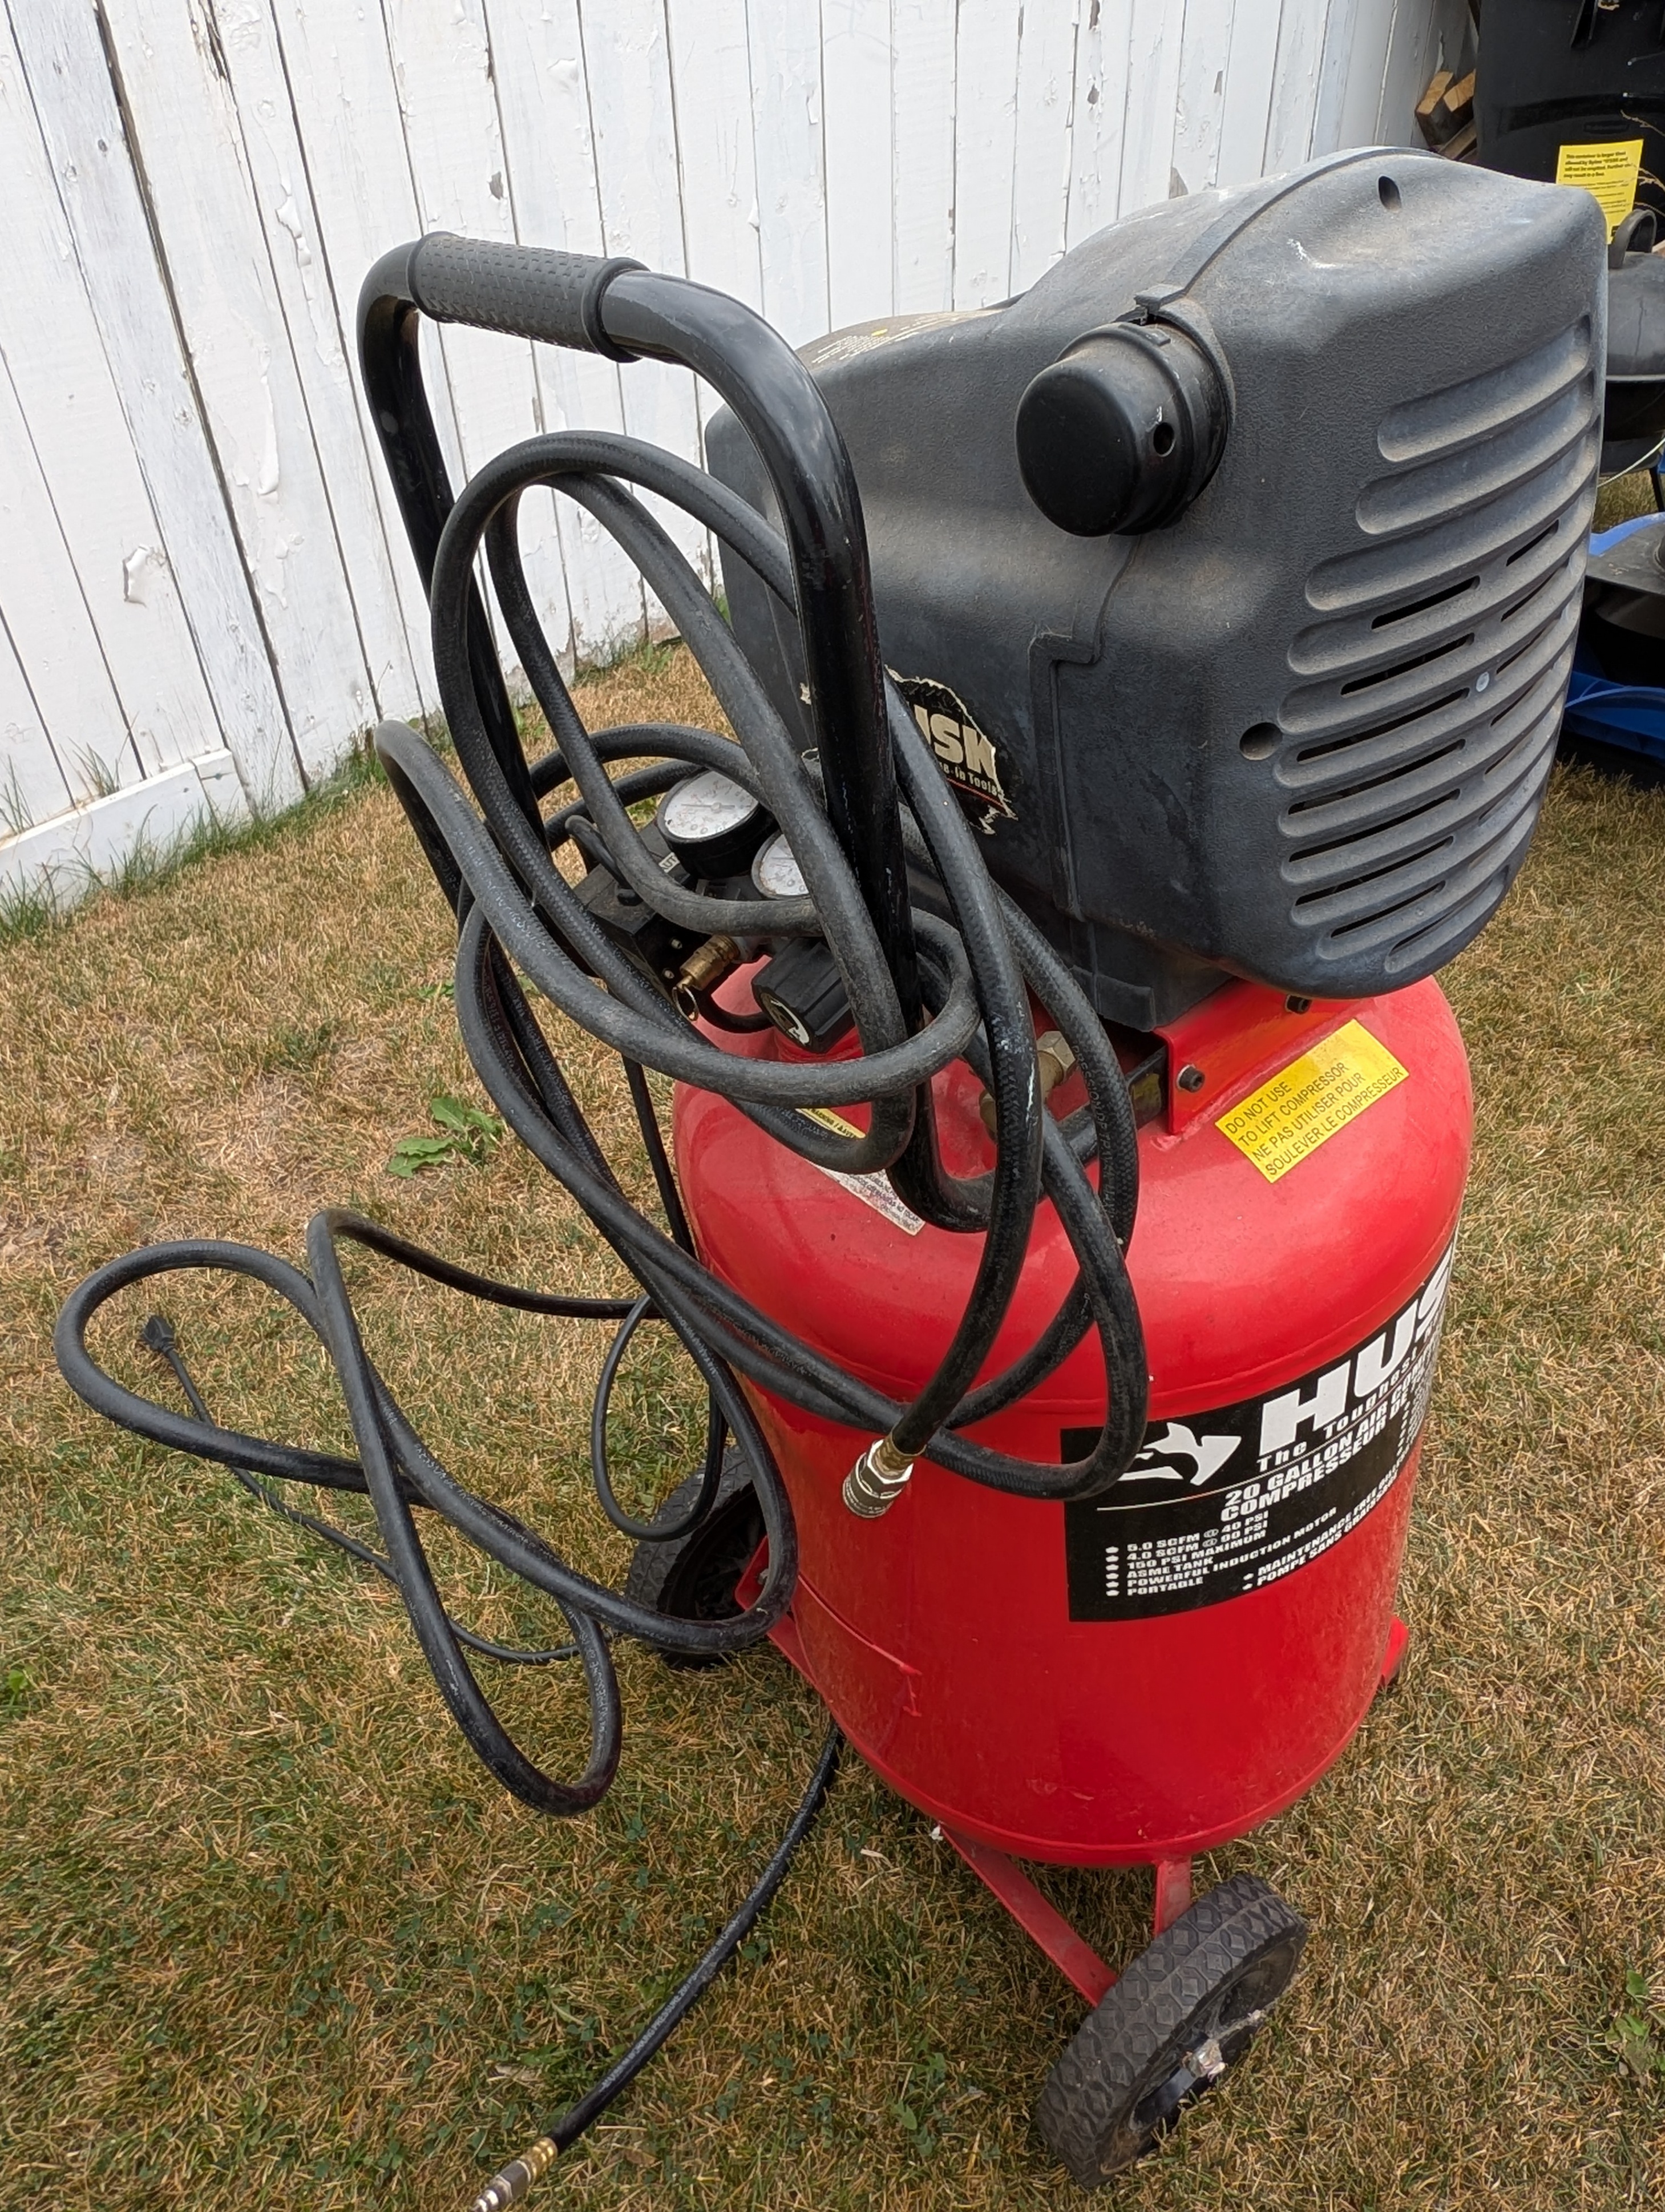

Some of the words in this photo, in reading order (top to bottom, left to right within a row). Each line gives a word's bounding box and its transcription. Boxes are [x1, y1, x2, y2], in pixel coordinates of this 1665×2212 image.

[1225, 1117, 1246, 1135] DO
[1243, 1098, 1270, 1121] NOT
[1268, 1081, 1292, 1103] USE
[1238, 1130, 1258, 1147] TO
[1256, 1111, 1282, 1135] LIFT
[1279, 1061, 1350, 1116] COMPRESSOR
[1252, 1143, 1272, 1162] NE
[1271, 1126, 1295, 1149] PAS
[1292, 1093, 1339, 1131] UTILISER
[1337, 1072, 1366, 1098] POUR
[1265, 1127, 1325, 1176] SOULEVER
[1323, 1116, 1339, 1133] LE
[1335, 1067, 1404, 1121] COMPRESSEUR
[1259, 1242, 1453, 1456] HUS
[1256, 1442, 1307, 1472] The
[1323, 1346, 1418, 1439] Toughest
[1220, 1414, 1387, 1522] COMPRESSEUR
[1224, 1483, 1261, 1508] 20
[1267, 1431, 1353, 1491] GALLON
[1355, 1400, 1388, 1439] AIR
[1126, 1551, 1152, 1561] 4.0
[1155, 1542, 1199, 1558] SCFM
[1202, 1537, 1218, 1548] @
[1244, 1520, 1268, 1535] PSI
[1127, 1568, 1210, 1588] POWERFUL
[1213, 1535, 1291, 1572] INDUCTION
[1294, 1507, 1337, 1539] MOTOR
[1127, 1559, 1157, 1570] 150
[1161, 1554, 1187, 1566] PSI
[1191, 1529, 1266, 1560] MAXIMUM
[1156, 1532, 1200, 1548] SCFM
[1203, 1528, 1219, 1539] @
[1221, 1521, 1242, 1533] 40
[1244, 1510, 1269, 1526] PSI
[1257, 1512, 1352, 1577] MAINTENANCE
[1257, 1556, 1306, 1587] POMPE
[1309, 1529, 1343, 1560] SANS
[1126, 1566, 1170, 1579] ASME
[1174, 1556, 1214, 1571] TANK
[1127, 1577, 1203, 1596] PORTABLE
